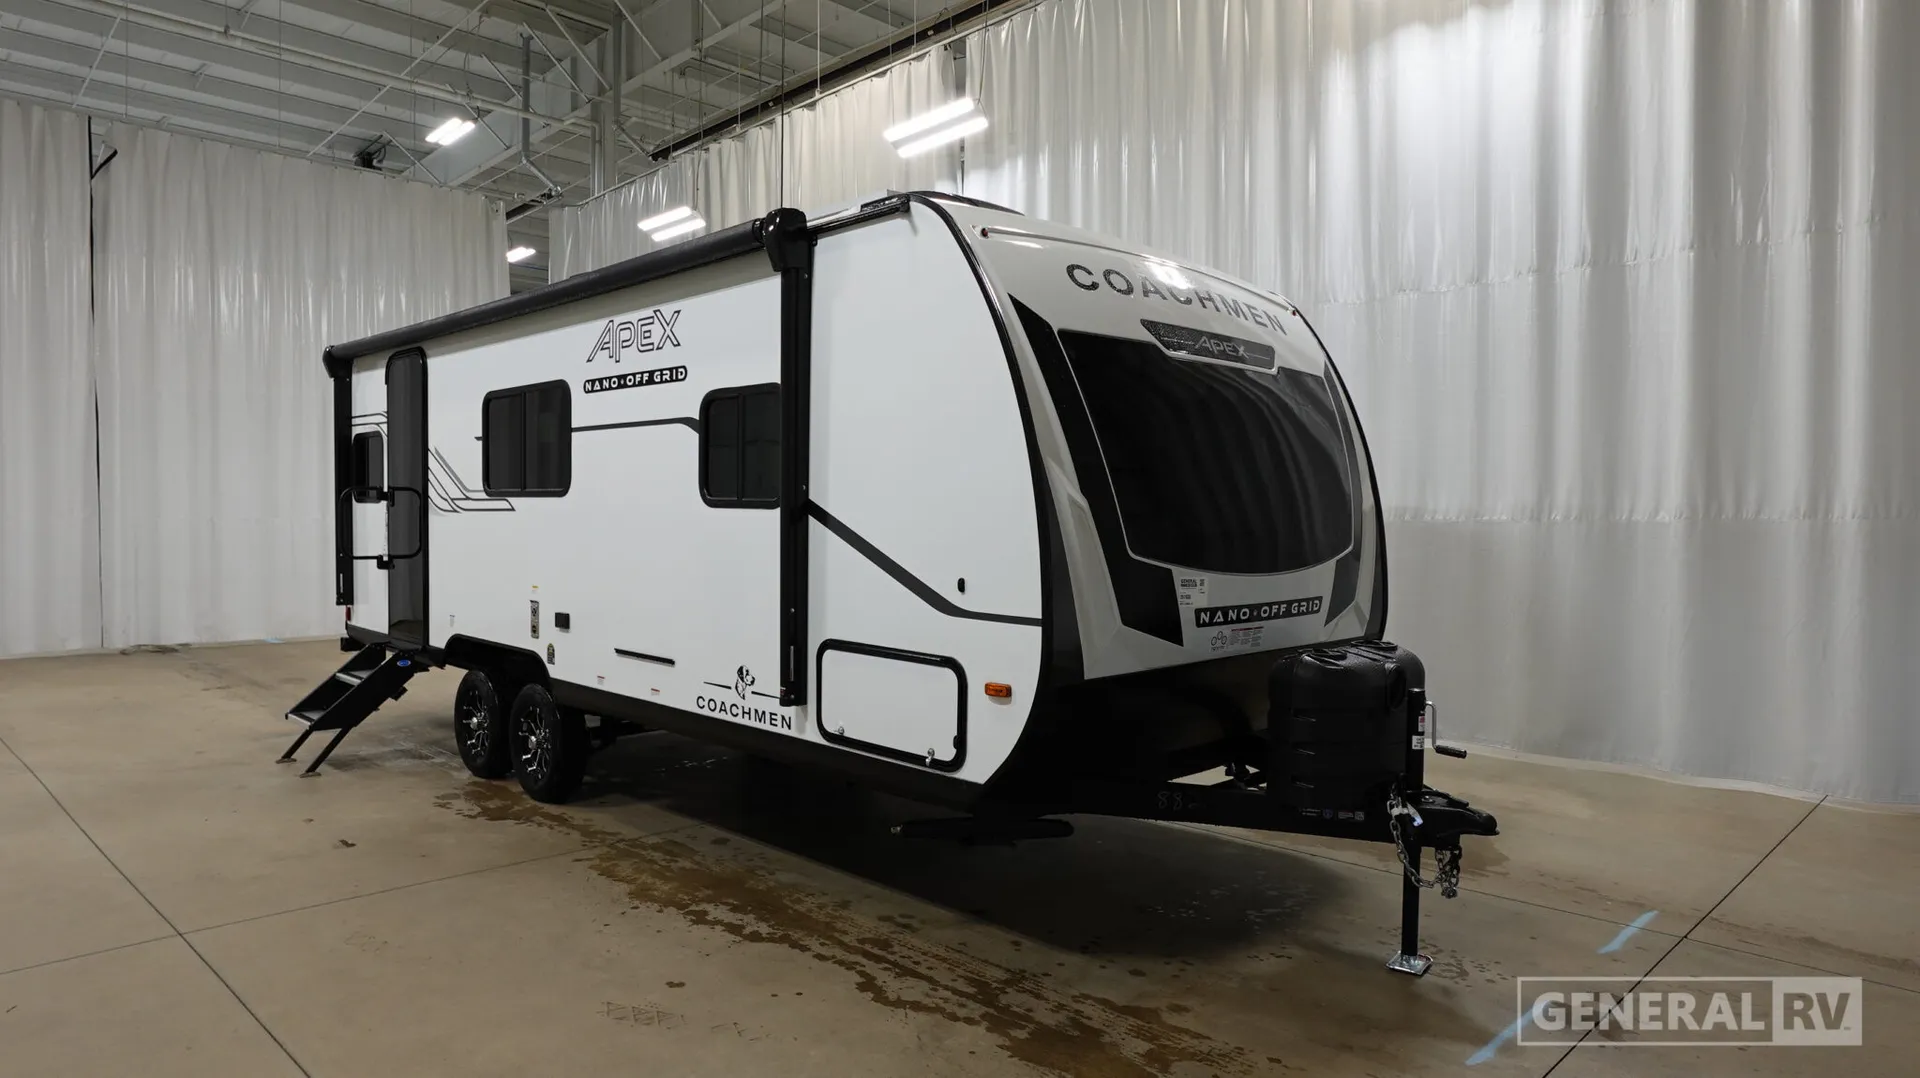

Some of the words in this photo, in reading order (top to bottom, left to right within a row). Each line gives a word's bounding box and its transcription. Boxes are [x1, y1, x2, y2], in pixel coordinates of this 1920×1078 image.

[1066, 263, 1288, 336] COACHMEN
[585, 377, 619, 392] NANO
[626, 373, 650, 386] OFF
[653, 368, 686, 382] GRID
[1200, 608, 1250, 624] NANO
[1260, 604, 1287, 618] OFF
[1291, 600, 1320, 613] GRID
[696, 695, 792, 731] COACHMEN
